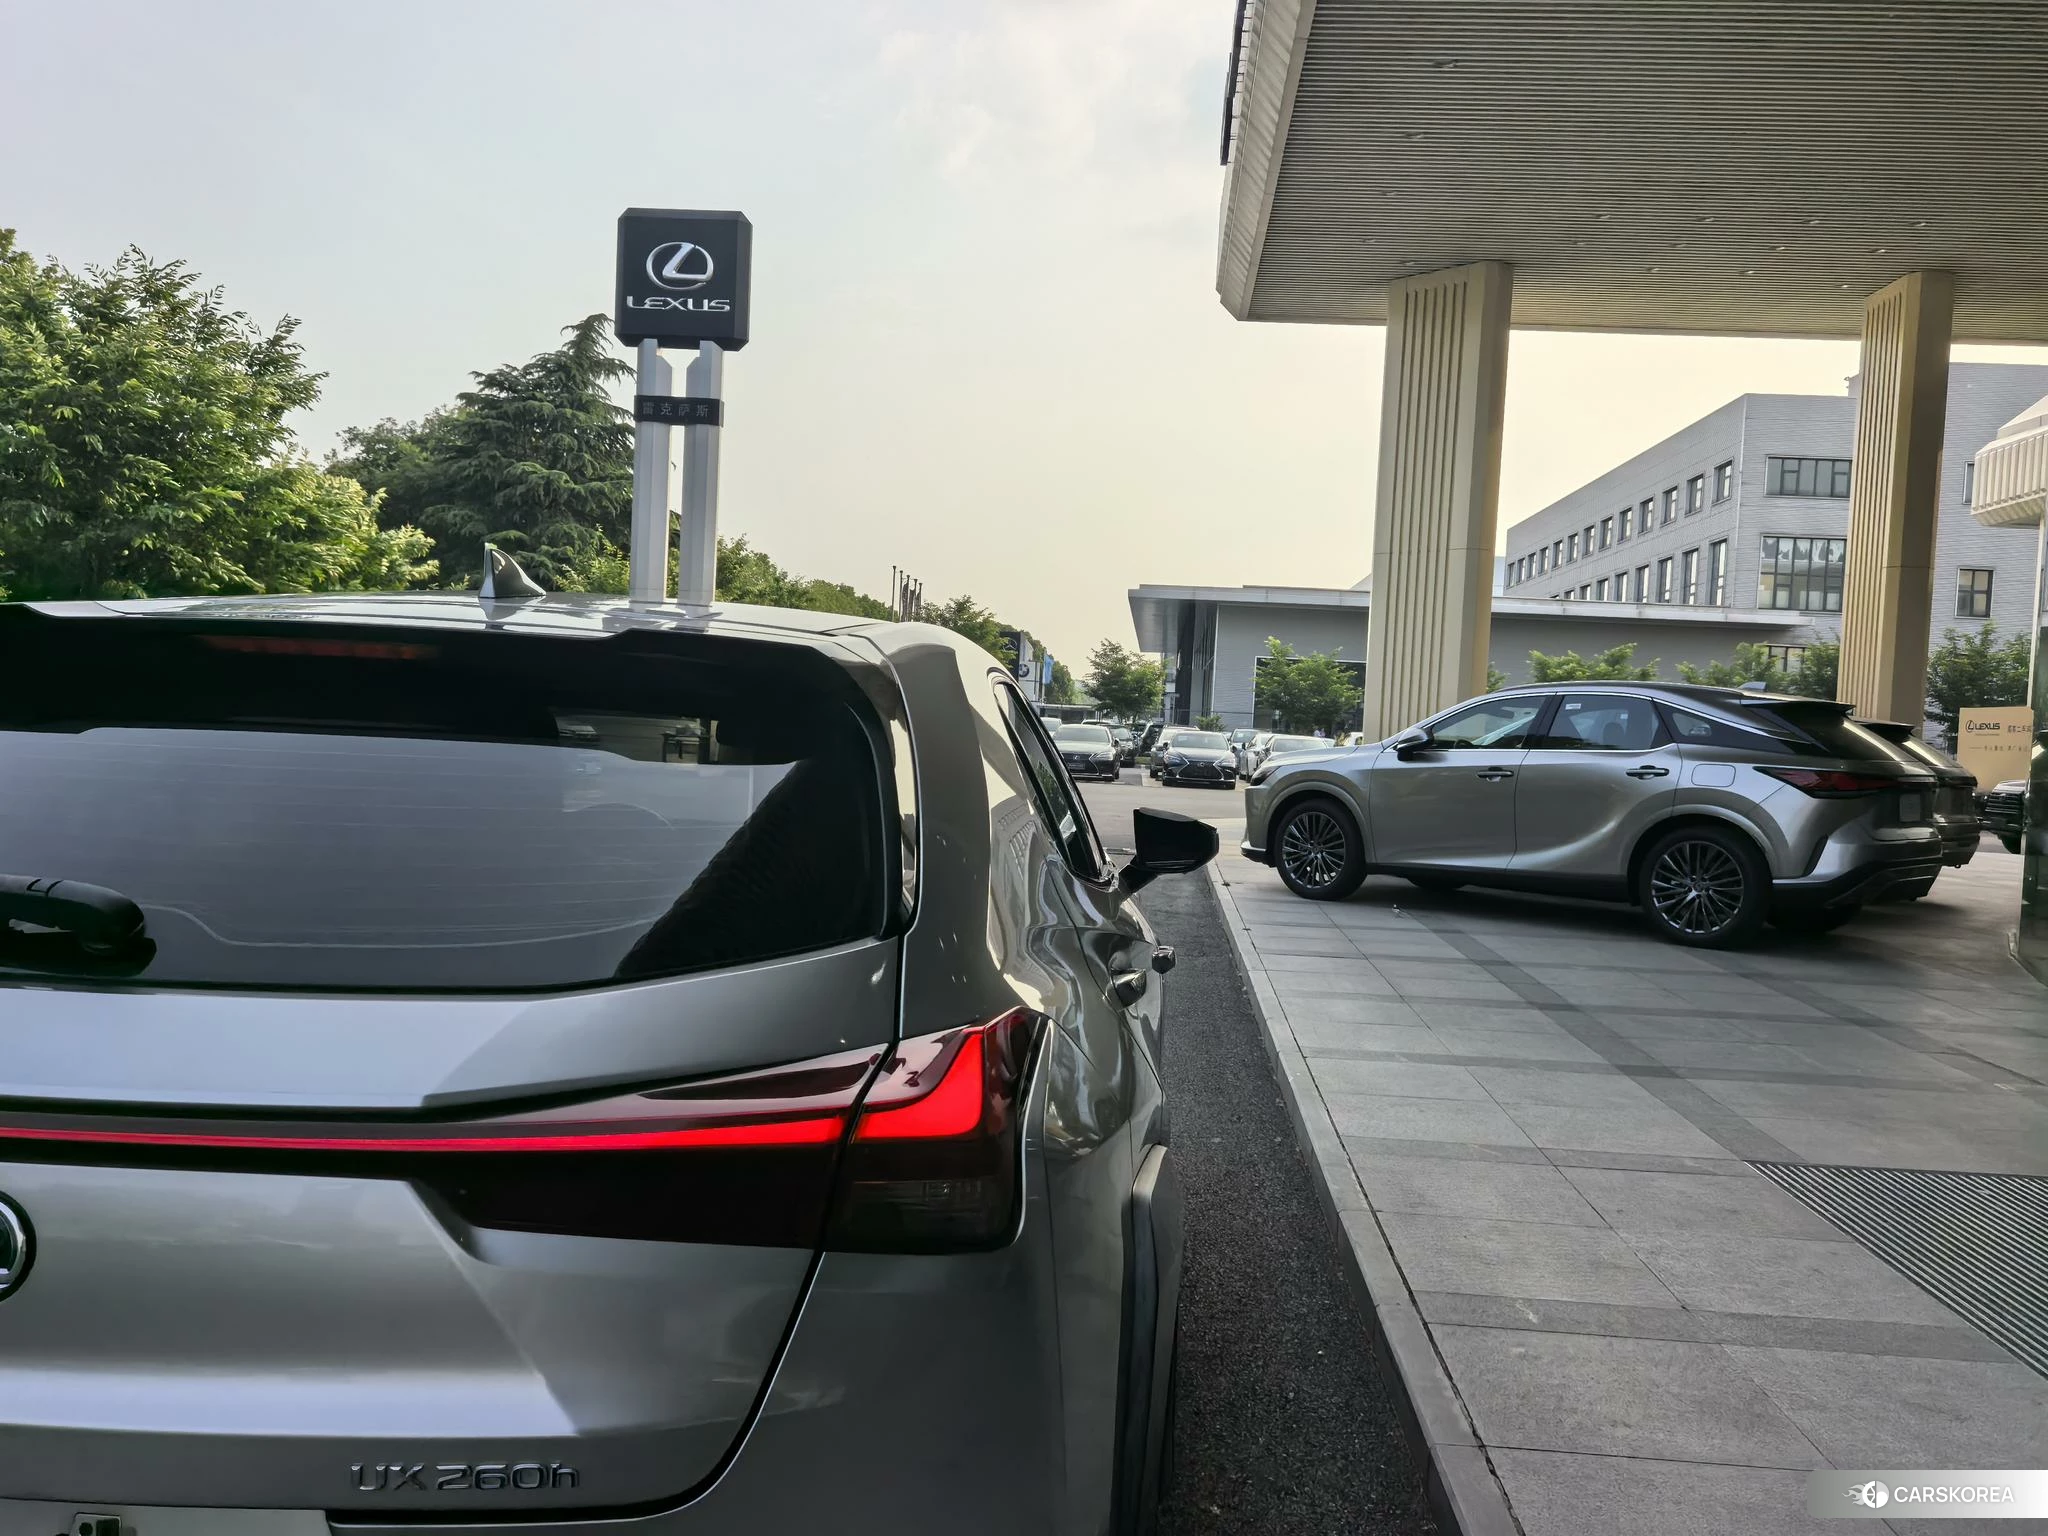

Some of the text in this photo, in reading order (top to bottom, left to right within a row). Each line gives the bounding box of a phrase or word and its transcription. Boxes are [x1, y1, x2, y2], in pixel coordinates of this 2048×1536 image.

[626, 296, 730, 312] LEXUS
[642, 401, 710, 417] 雷克萨斯
[1974, 722, 2001, 731] LEXUS
[351, 1460, 580, 1492] UX 260h
